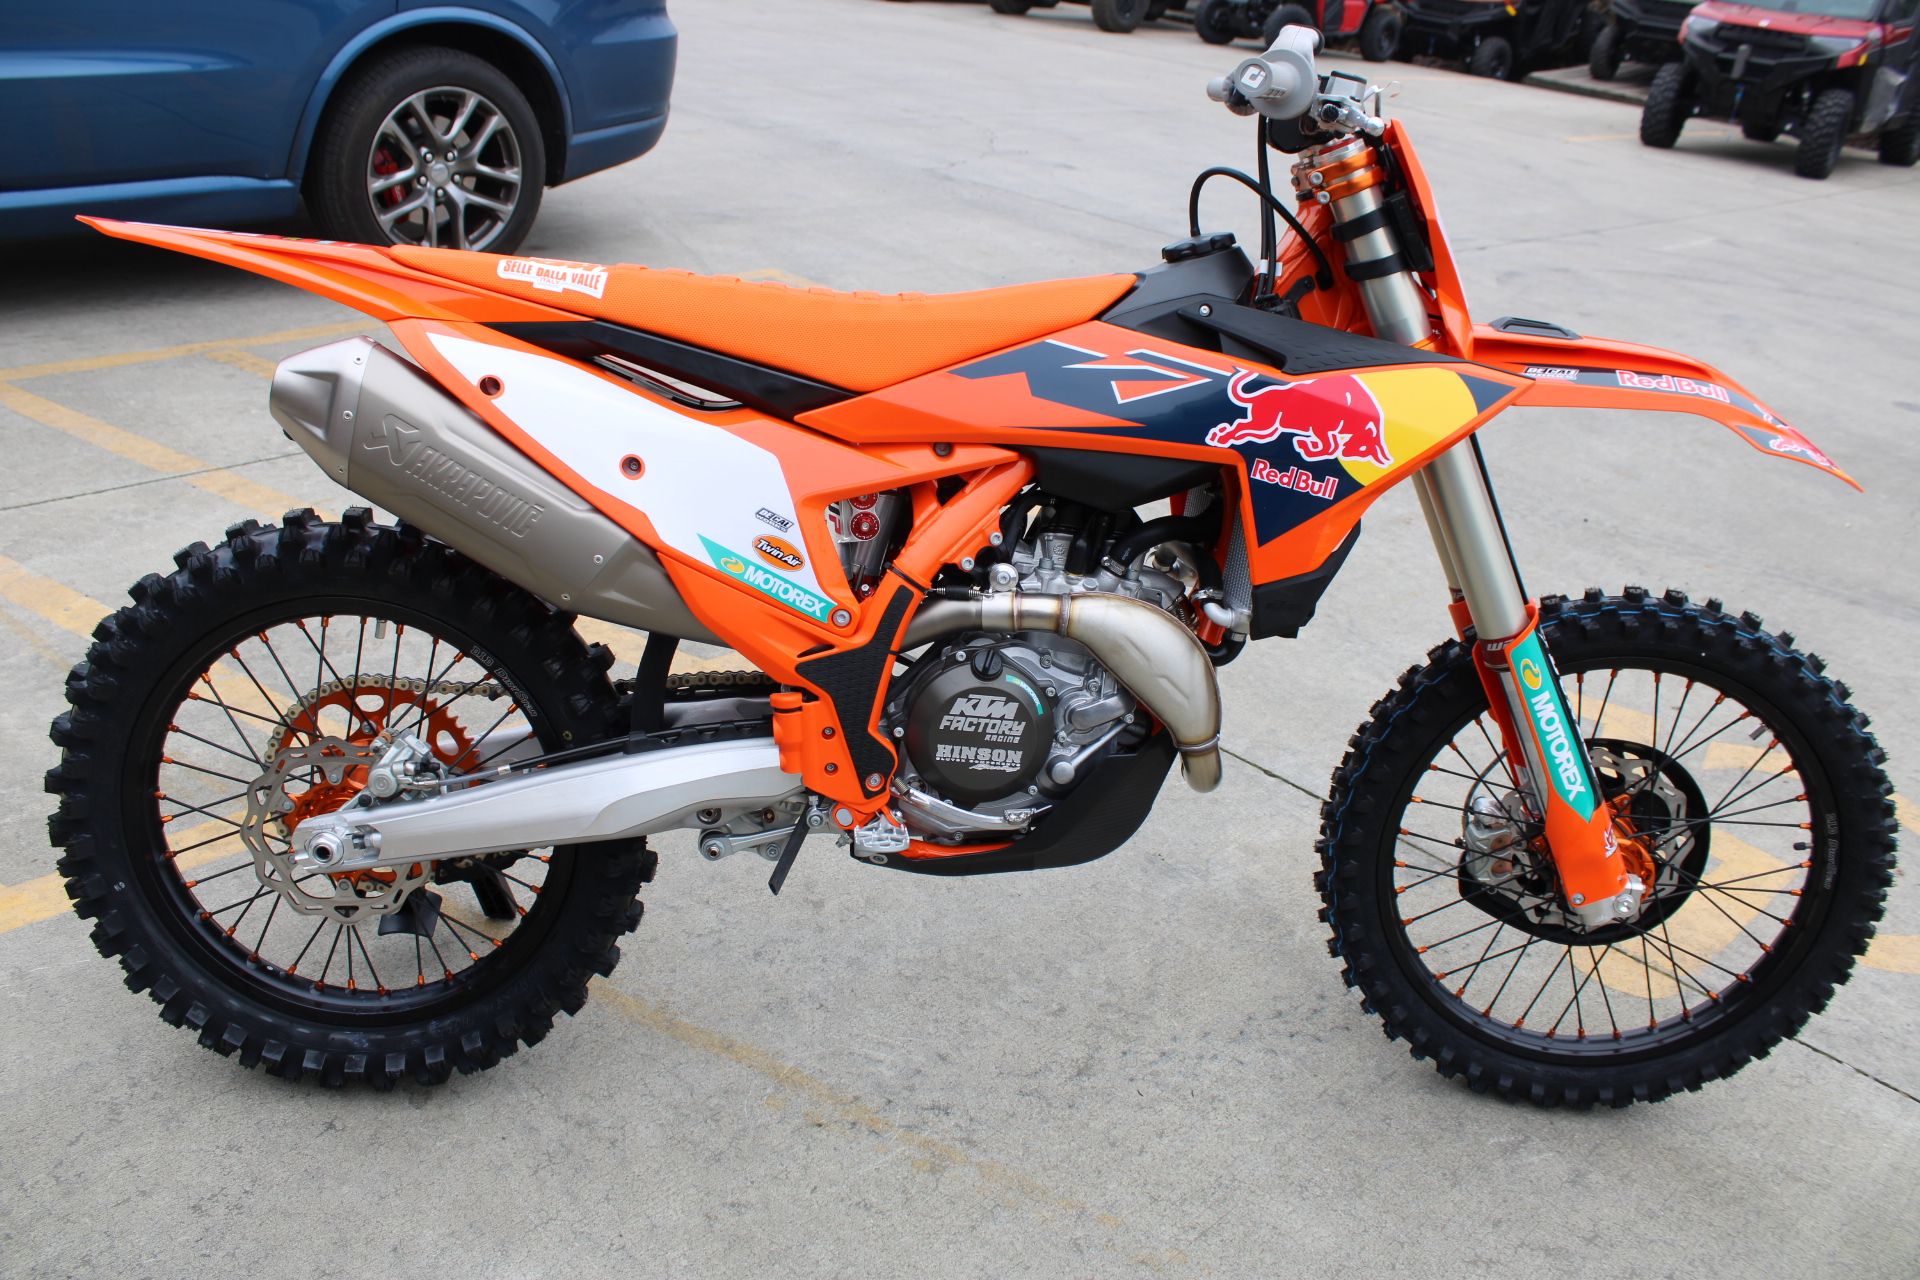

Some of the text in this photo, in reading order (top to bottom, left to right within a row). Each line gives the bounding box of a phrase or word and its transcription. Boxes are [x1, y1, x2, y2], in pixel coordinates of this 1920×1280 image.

[503, 260, 601, 291] SELLE DALLA VALLE
[1616, 369, 1730, 403] Red Bull
[1250, 457, 1339, 501] Red Bull
[757, 509, 791, 528] DECAL
[743, 565, 827, 617] MOTOREX
[949, 693, 1020, 720] KTM
[938, 714, 1026, 737] FACTORY
[984, 734, 1021, 744] RACING
[935, 743, 1023, 765] HINSON
[1531, 690, 1586, 802] MOTOREX
